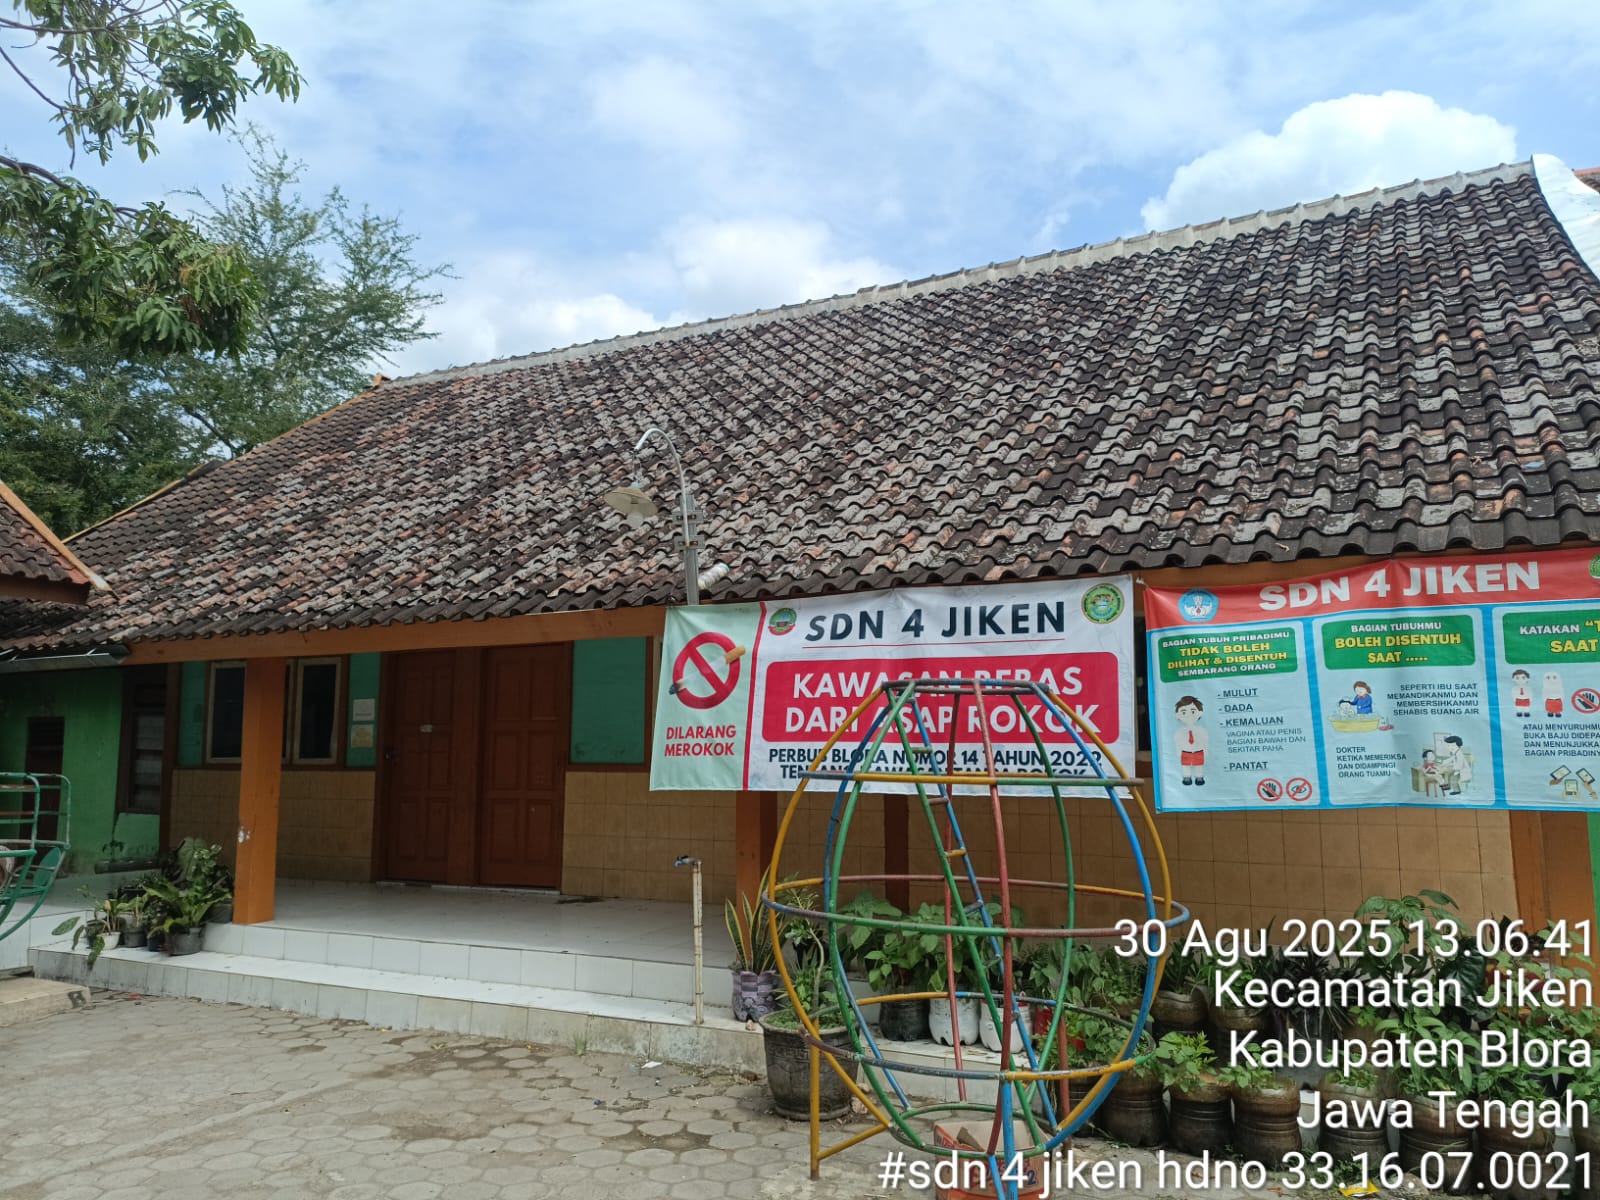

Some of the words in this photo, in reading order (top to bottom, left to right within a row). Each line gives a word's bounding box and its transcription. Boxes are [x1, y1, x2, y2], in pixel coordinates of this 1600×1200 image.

[1258, 576, 1350, 611] SDN
[1364, 568, 1390, 597] 4
[1403, 561, 1540, 596] JIKEN
[805, 610, 884, 642] SDN
[901, 608, 924, 638] 4
[941, 601, 1065, 638] JIKEN
[1351, 623, 1387, 633] BAGIAN
[1391, 622, 1442, 631] TUBUHMU
[1519, 624, 1580, 635] KATAKAN
[1162, 637, 1196, 648] BAGIAN
[1198, 635, 1230, 644] TUBUH
[1233, 631, 1290, 642] PRIBADIMU
[1335, 636, 1381, 648] BOLEH
[1385, 633, 1461, 646] DISENTUH
[1179, 645, 1219, 657] TIDAK
[1223, 642, 1270, 654] BOLEH
[1550, 638, 1599, 653] SAAT
[1168, 658, 1210, 670] DILIHAT
[1213, 656, 1222, 665] &
[1226, 652, 1288, 664] DISENTUH
[1368, 651, 1402, 663] SAAT
[1178, 665, 1237, 677] SEMBARANG
[1240, 663, 1276, 671] ORANG
[1400, 683, 1436, 691] SEPERTI
[1455, 682, 1478, 690] SAAT
[1223, 688, 1258, 697] MULUT
[1224, 703, 1254, 713] DADA
[785, 706, 859, 734] DARI
[967, 704, 1101, 734] ROKOK
[1225, 716, 1284, 727] KEMALUAN
[666, 725, 737, 740] DILARANG
[1226, 729, 1255, 737] VAGINA
[1256, 728, 1276, 736] ATAU
[1277, 727, 1302, 735] PENIS
[1226, 738, 1256, 746] BAGIAN
[1524, 740, 1541, 748] DAN
[664, 742, 735, 757] MEROKOK
[1228, 745, 1260, 753] SEKITAR
[1336, 746, 1366, 754] DOKTER
[1525, 749, 1556, 757] BAGIAN
[961, 750, 978, 765] 14
[982, 750, 1044, 766] AHUN
[1364, 753, 1407, 761] MEMERIKSA
[1229, 761, 1269, 771] PANTAT
